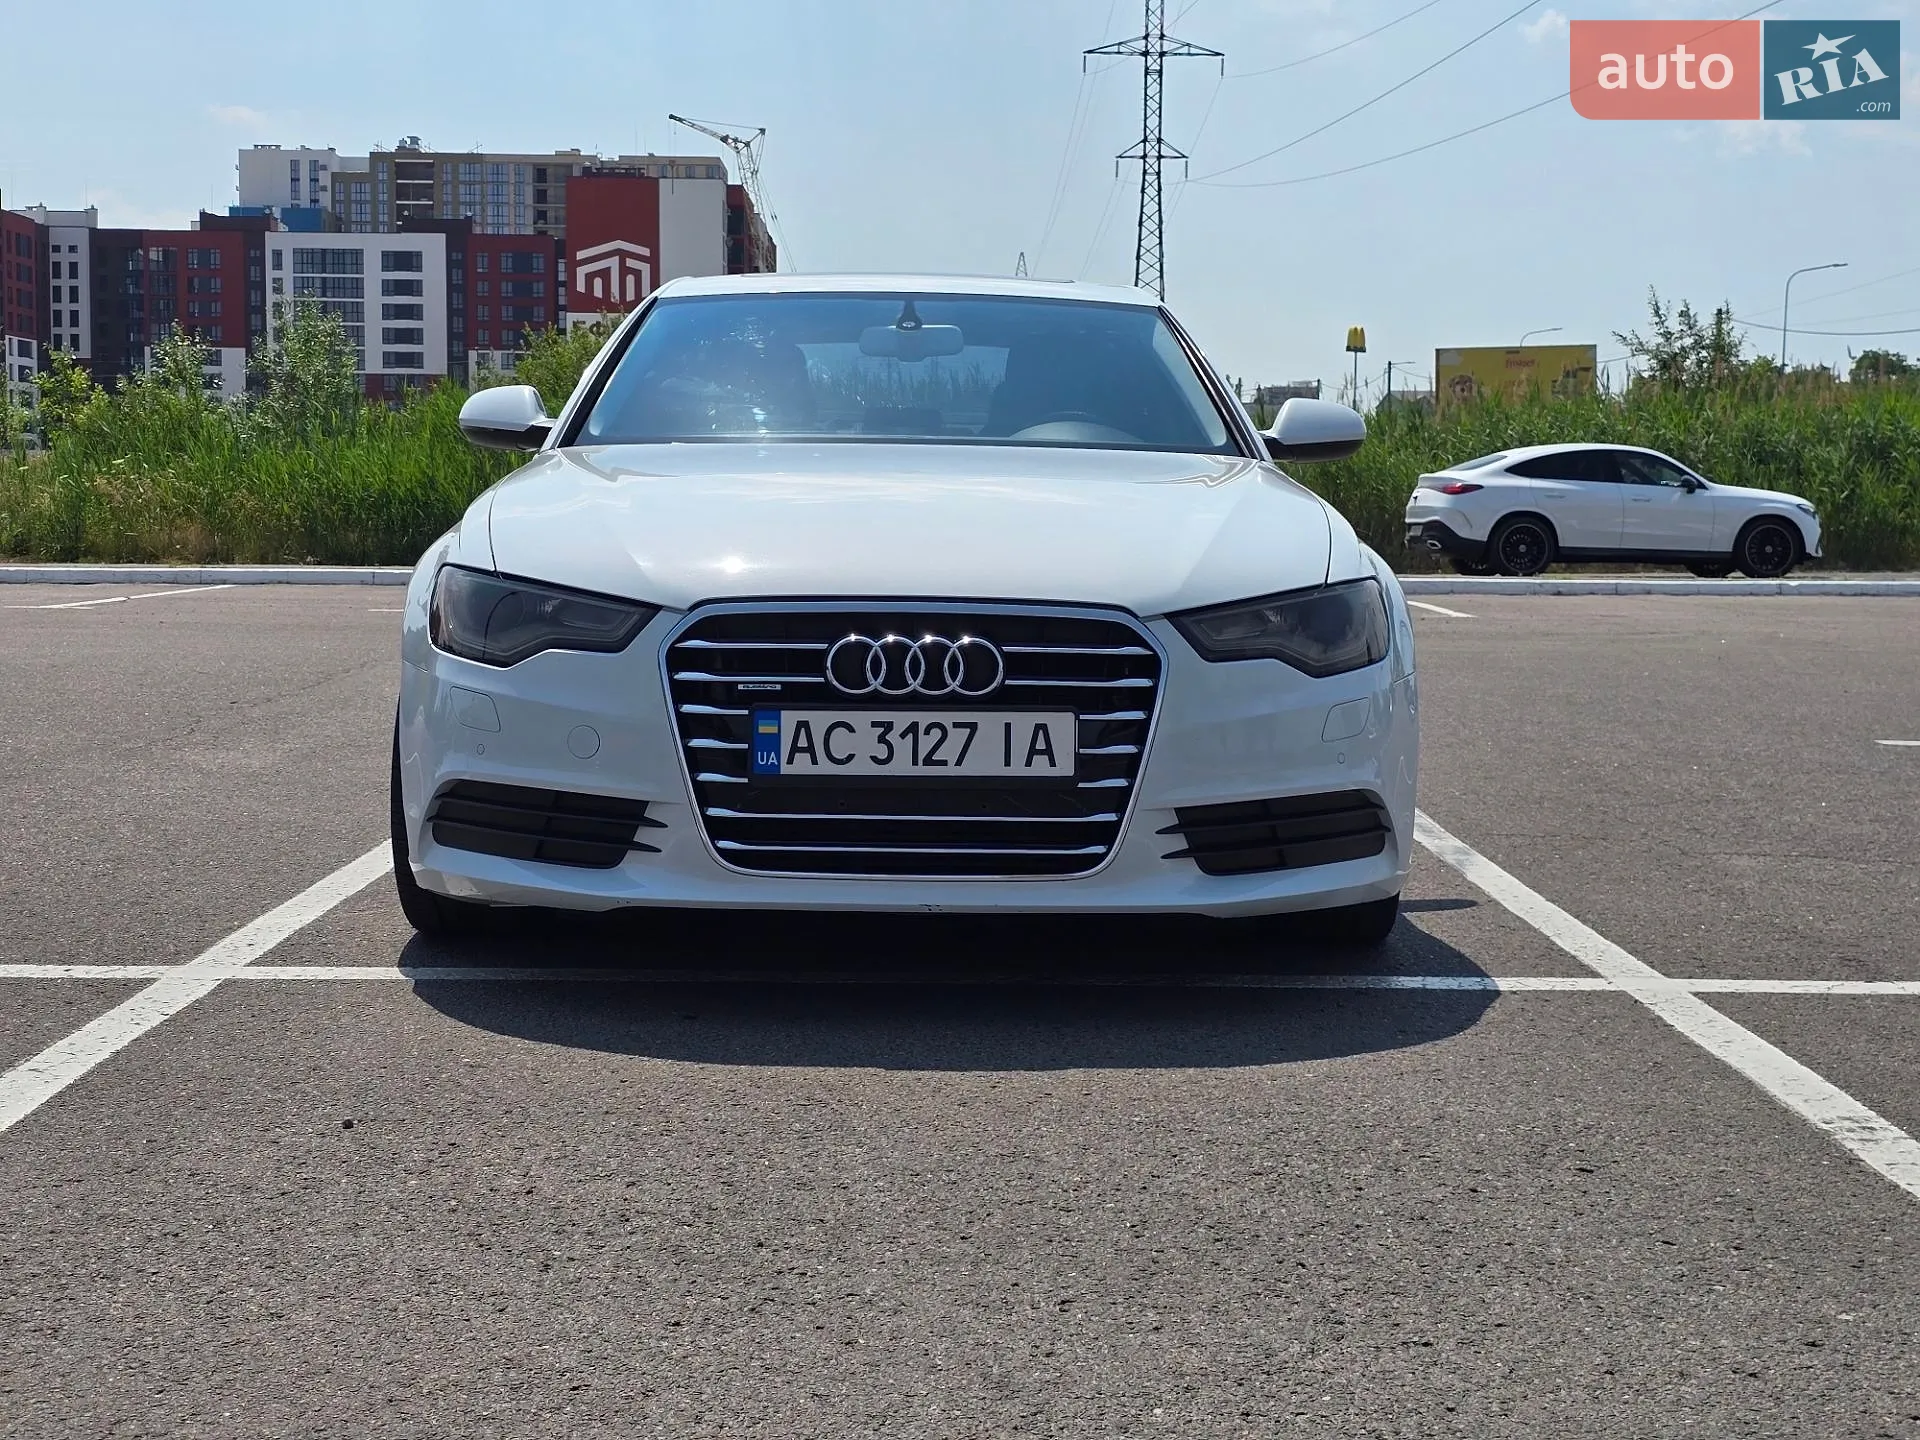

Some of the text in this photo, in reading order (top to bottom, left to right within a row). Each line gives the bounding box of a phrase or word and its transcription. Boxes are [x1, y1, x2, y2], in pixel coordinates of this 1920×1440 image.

[757, 751, 778, 765] UA
[785, 719, 1057, 768] AC 3127 IA
